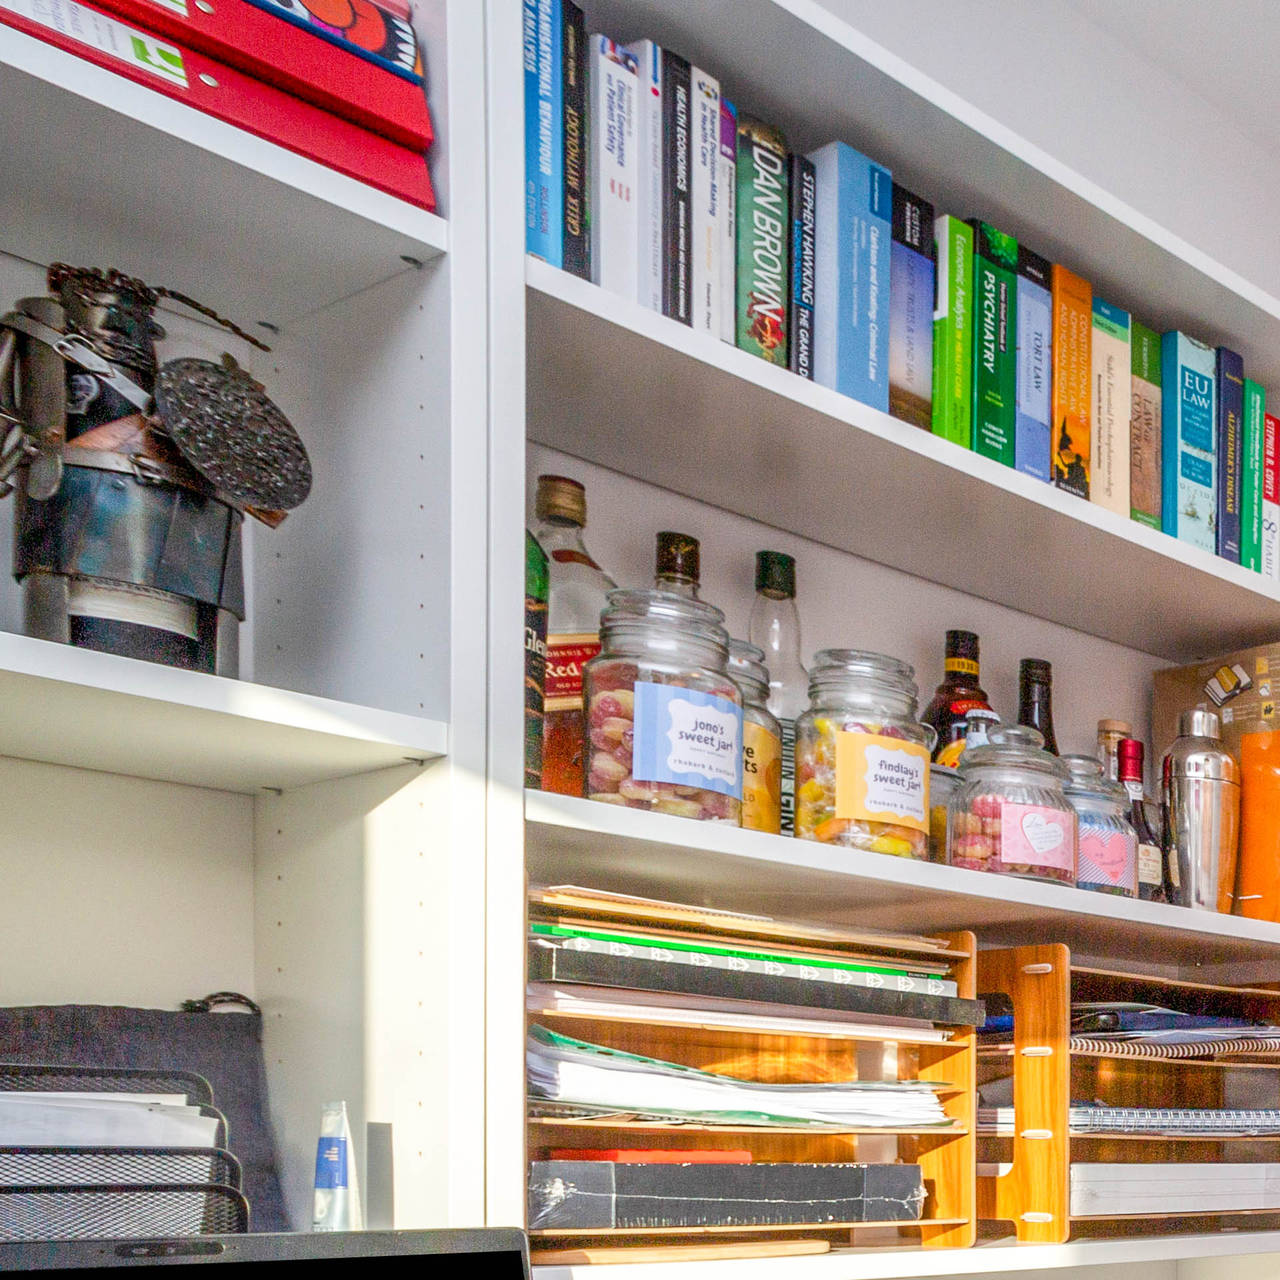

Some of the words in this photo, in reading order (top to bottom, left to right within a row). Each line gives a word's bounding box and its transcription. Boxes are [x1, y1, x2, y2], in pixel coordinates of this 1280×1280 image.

[606, 87, 616, 122] Patient
[616, 79, 627, 113] Clinical
[677, 84, 688, 129] HEALTH
[539, 100, 553, 176] BEHAVIOUR
[566, 104, 580, 190] MYTHOLOGY
[605, 122, 617, 155] Safety
[616, 112, 627, 168] Governance
[701, 113, 709, 144] Health
[677, 127, 688, 192] ECONOMICS
[752, 144, 783, 217] DAN
[801, 171, 815, 236] STEPHEN
[911, 204, 922, 247] CUSTOM
[869, 225, 880, 265] Clarkson
[954, 233, 967, 287] Economic
[752, 209, 783, 323] BROWN
[800, 232, 815, 307] HAWKING
[799, 307, 810, 329] THE
[953, 286, 966, 330] Analysis
[983, 270, 997, 373] PSYCHIATRY
[799, 327, 810, 365] GRAND
[868, 322, 879, 360] Criminal
[1033, 331, 1043, 363] TORT
[1033, 364, 1043, 393] LAW
[1185, 370, 1208, 395] EU
[1143, 398, 1153, 430] LAW
[1183, 388, 1210, 409] LAW
[1132, 392, 1143, 472] CONTRACT
[1226, 410, 1236, 474] ALZHEIMER'S
[1265, 418, 1276, 455] STEPHEN
[1225, 474, 1235, 514] DISEASE
[1264, 467, 1275, 499] COVEY
[545, 660, 581, 679] Red
[677, 730, 715, 748] sweet
[691, 717, 725, 736] jono's
[873, 773, 906, 789] sweet
[878, 759, 919, 780] findlay's
